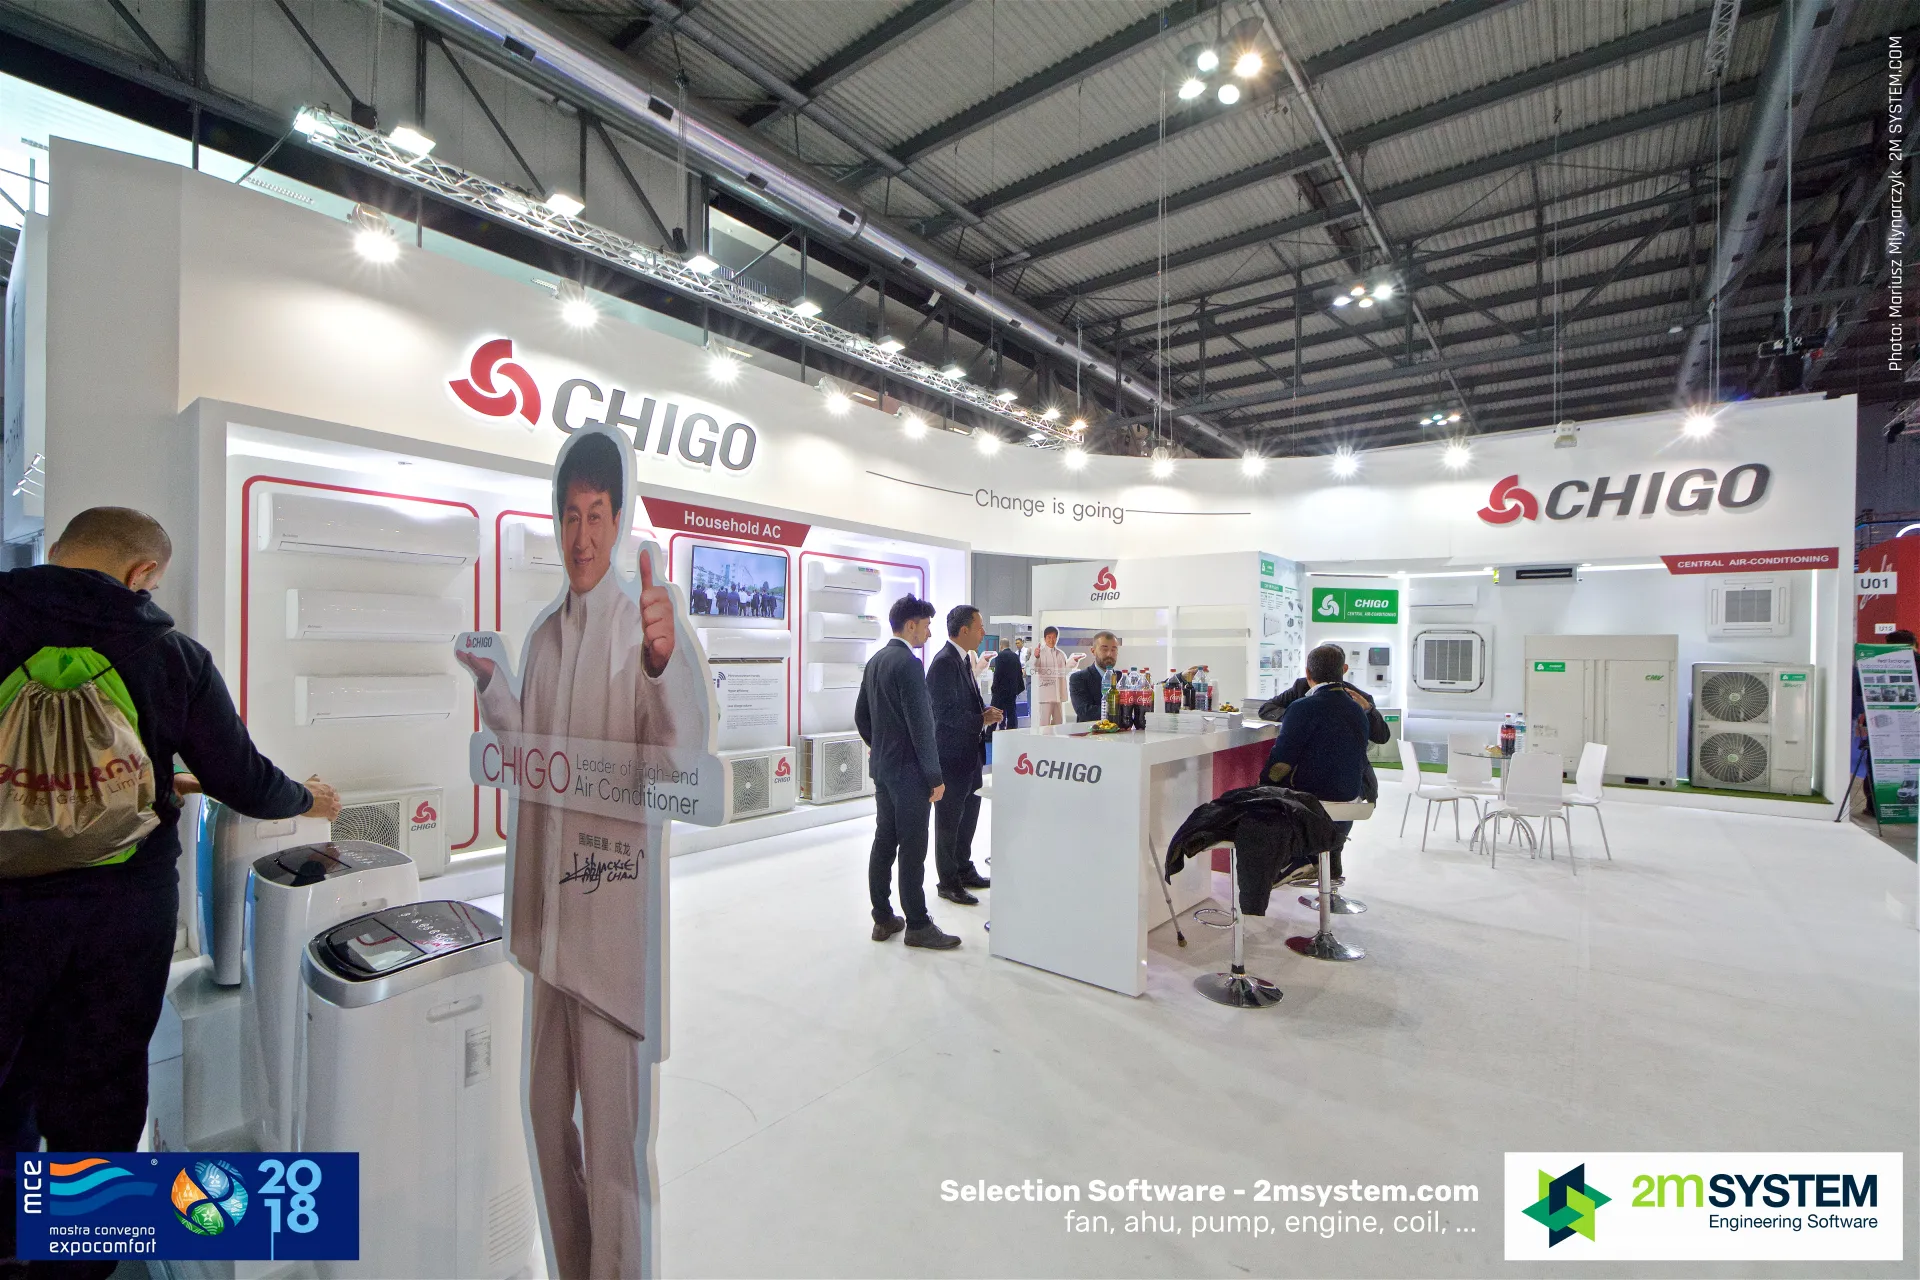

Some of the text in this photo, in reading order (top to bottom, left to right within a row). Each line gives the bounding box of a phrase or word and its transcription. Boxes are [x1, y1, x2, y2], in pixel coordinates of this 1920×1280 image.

[552, 378, 757, 471] CHIGO
[1544, 463, 1771, 520] CHIGO
[975, 488, 1125, 525] Change is going
[683, 510, 782, 539] Household AC
[1677, 554, 1830, 569] CENTRAL AIR-CONDITIONING
[1860, 578, 1889, 589] U01
[1090, 591, 1121, 602] CHIGO
[1354, 598, 1390, 609] CHIGO
[472, 635, 493, 649] CHIGO
[482, 742, 571, 794] CHIGO
[576, 754, 699, 787] Leader of High-end
[774, 776, 791, 785] CHIGO
[1035, 759, 1102, 784] CHIGO
[574, 775, 699, 816] Air Conditioner
[410, 822, 437, 832] CHIGO
